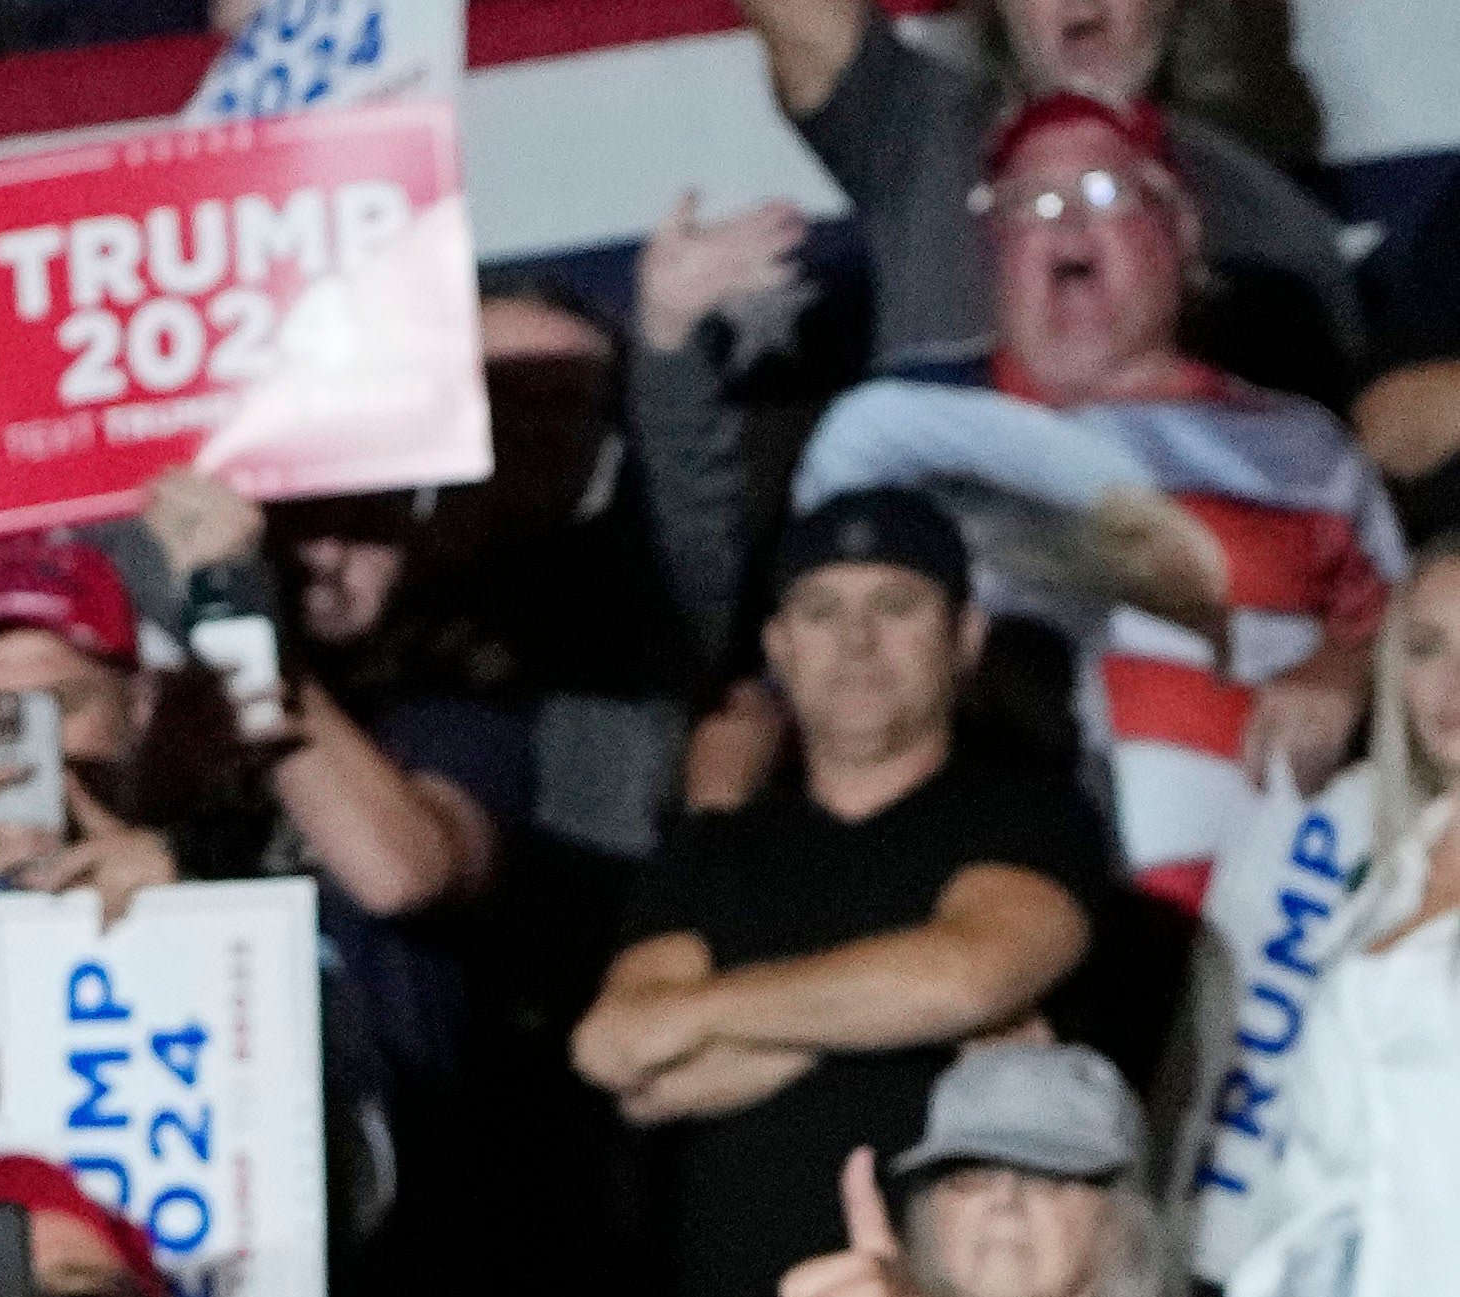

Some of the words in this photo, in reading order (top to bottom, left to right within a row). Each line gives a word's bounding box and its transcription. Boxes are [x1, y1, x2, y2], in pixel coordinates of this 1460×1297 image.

[57, 280, 359, 405] 2024
[67, 956, 132, 1213] UMP
[1198, 811, 1345, 1196] TRUMP
